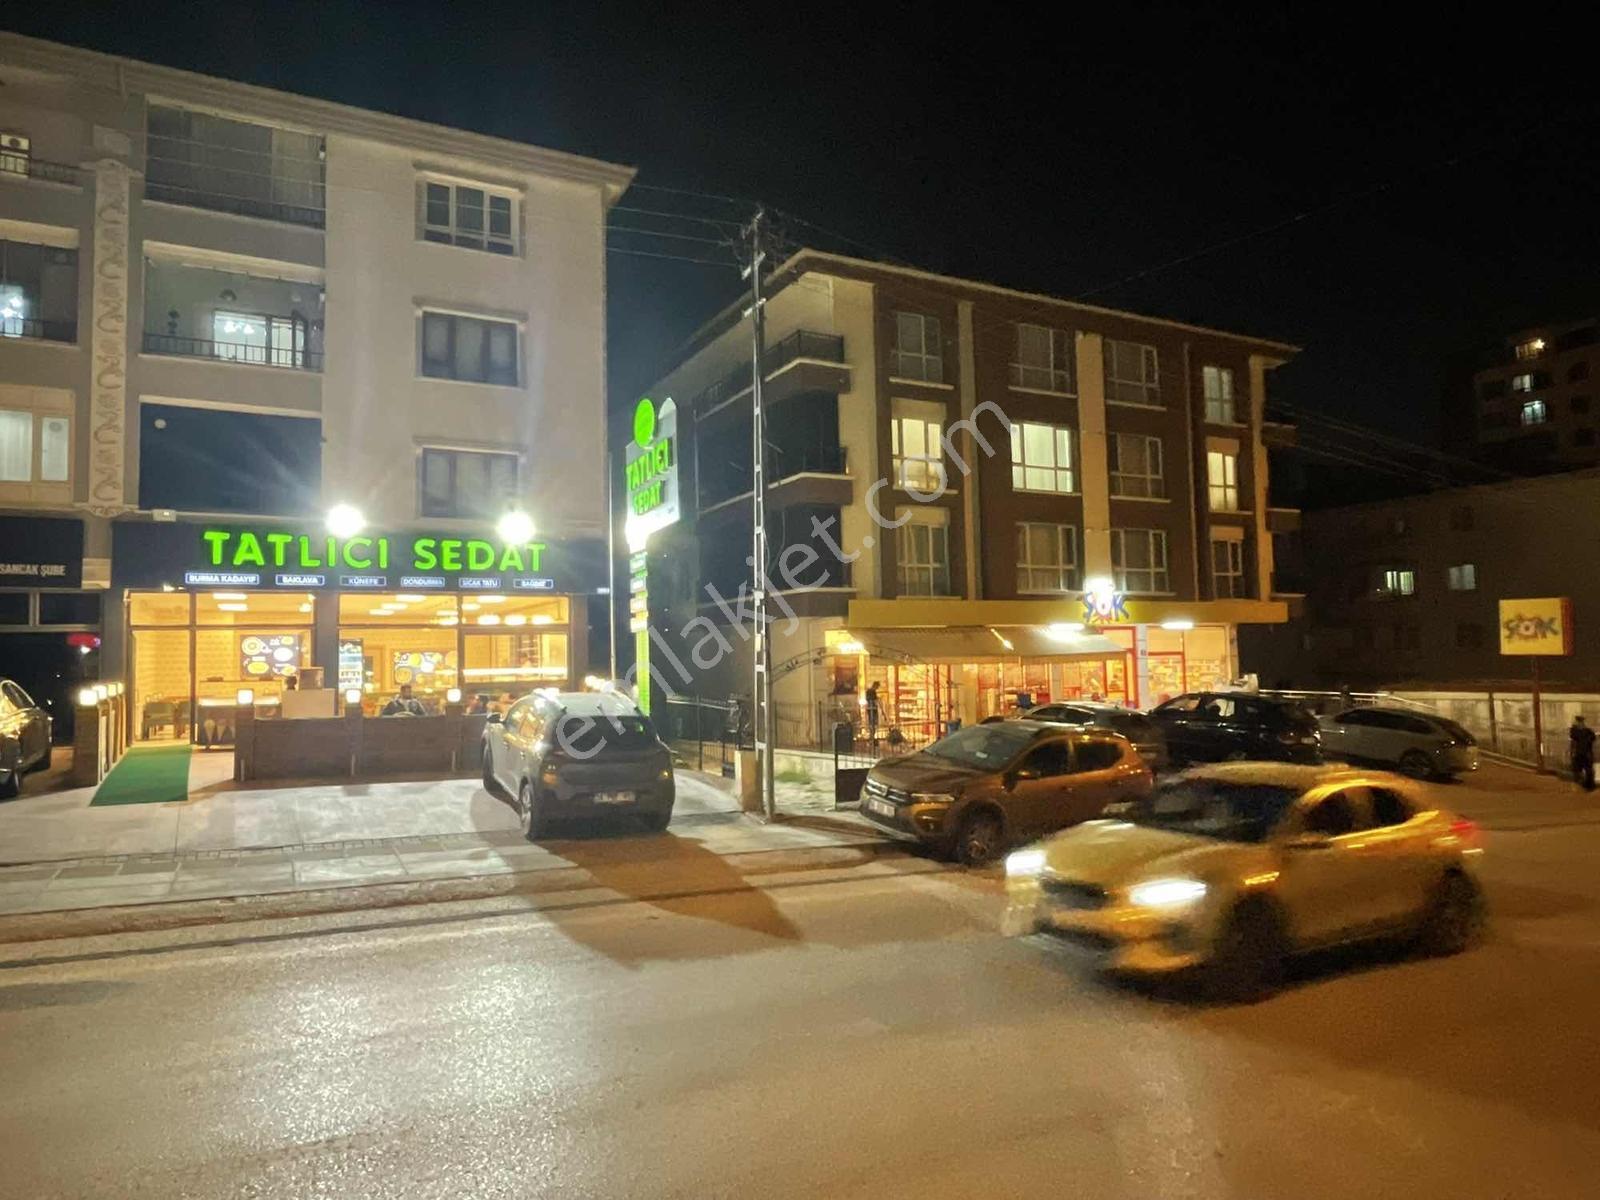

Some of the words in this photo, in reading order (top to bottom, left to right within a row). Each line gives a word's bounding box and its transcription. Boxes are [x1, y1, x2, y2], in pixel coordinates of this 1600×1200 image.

[626, 438, 668, 491] TATLICI
[203, 531, 388, 569] TATLICI
[414, 538, 546, 572] SEDAT
[282, 576, 318, 584] BAKLAVA
